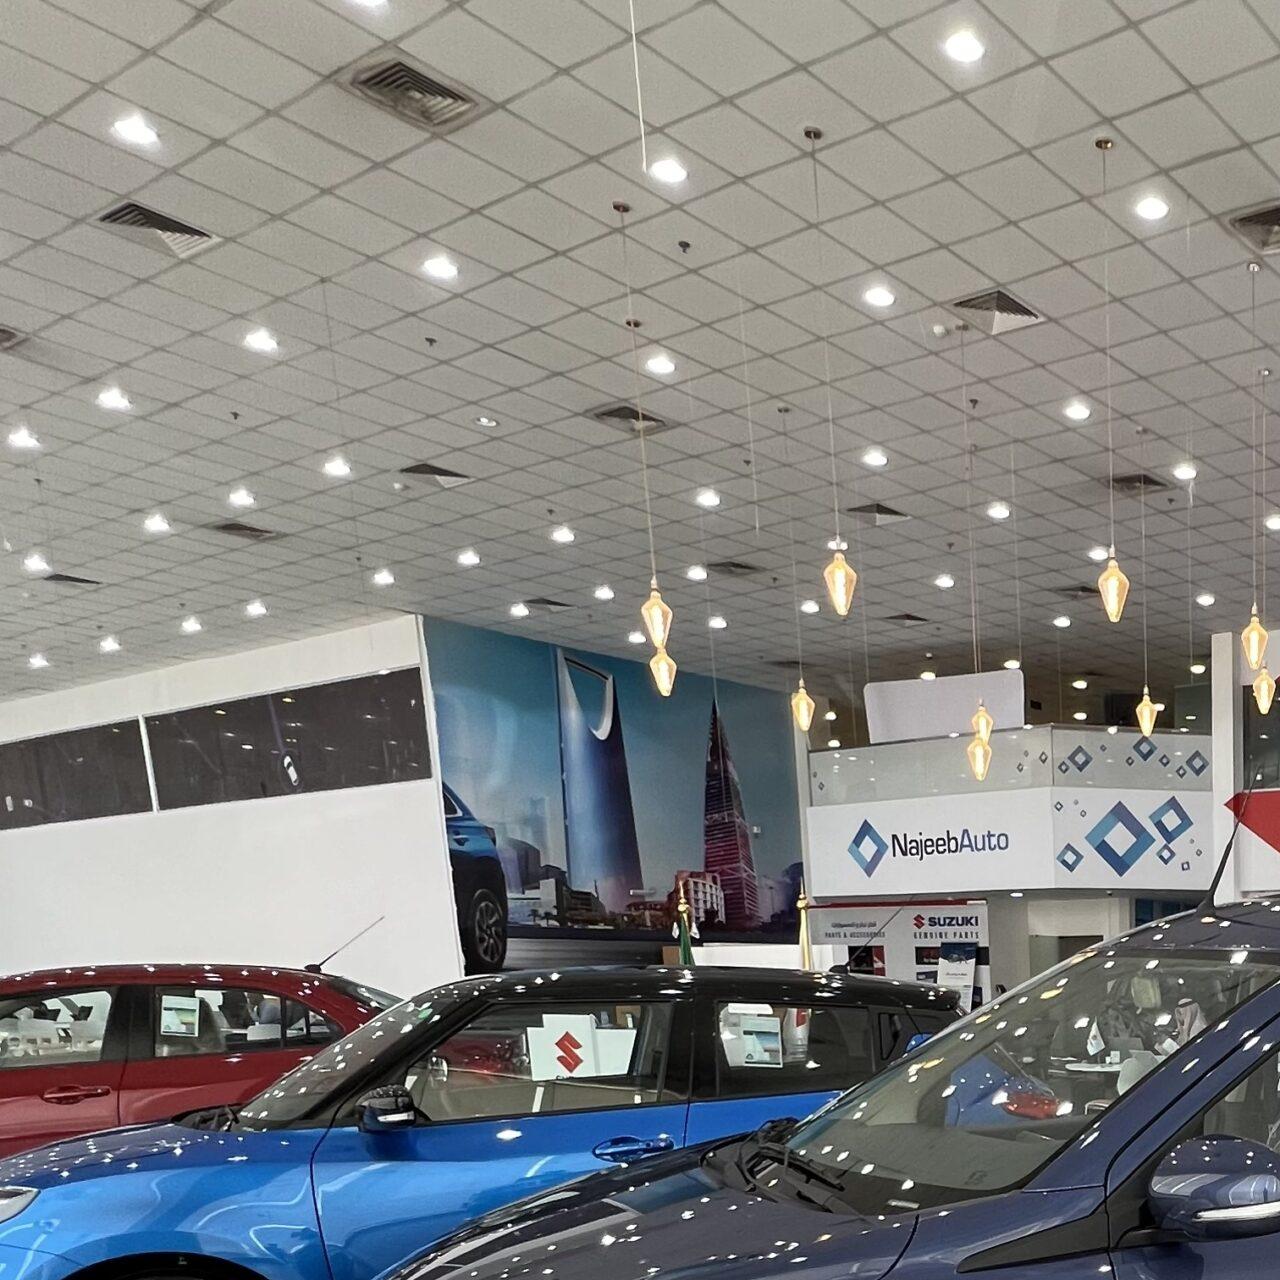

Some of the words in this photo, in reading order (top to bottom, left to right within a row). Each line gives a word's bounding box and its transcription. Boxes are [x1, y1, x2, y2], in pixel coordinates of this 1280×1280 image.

[891, 828, 1009, 862] NajeebAuto
[928, 915, 979, 927] SUZUKI
[825, 931, 842, 939] PARTS
[913, 931, 948, 939] GENUINE
[953, 931, 979, 939] PARTS
